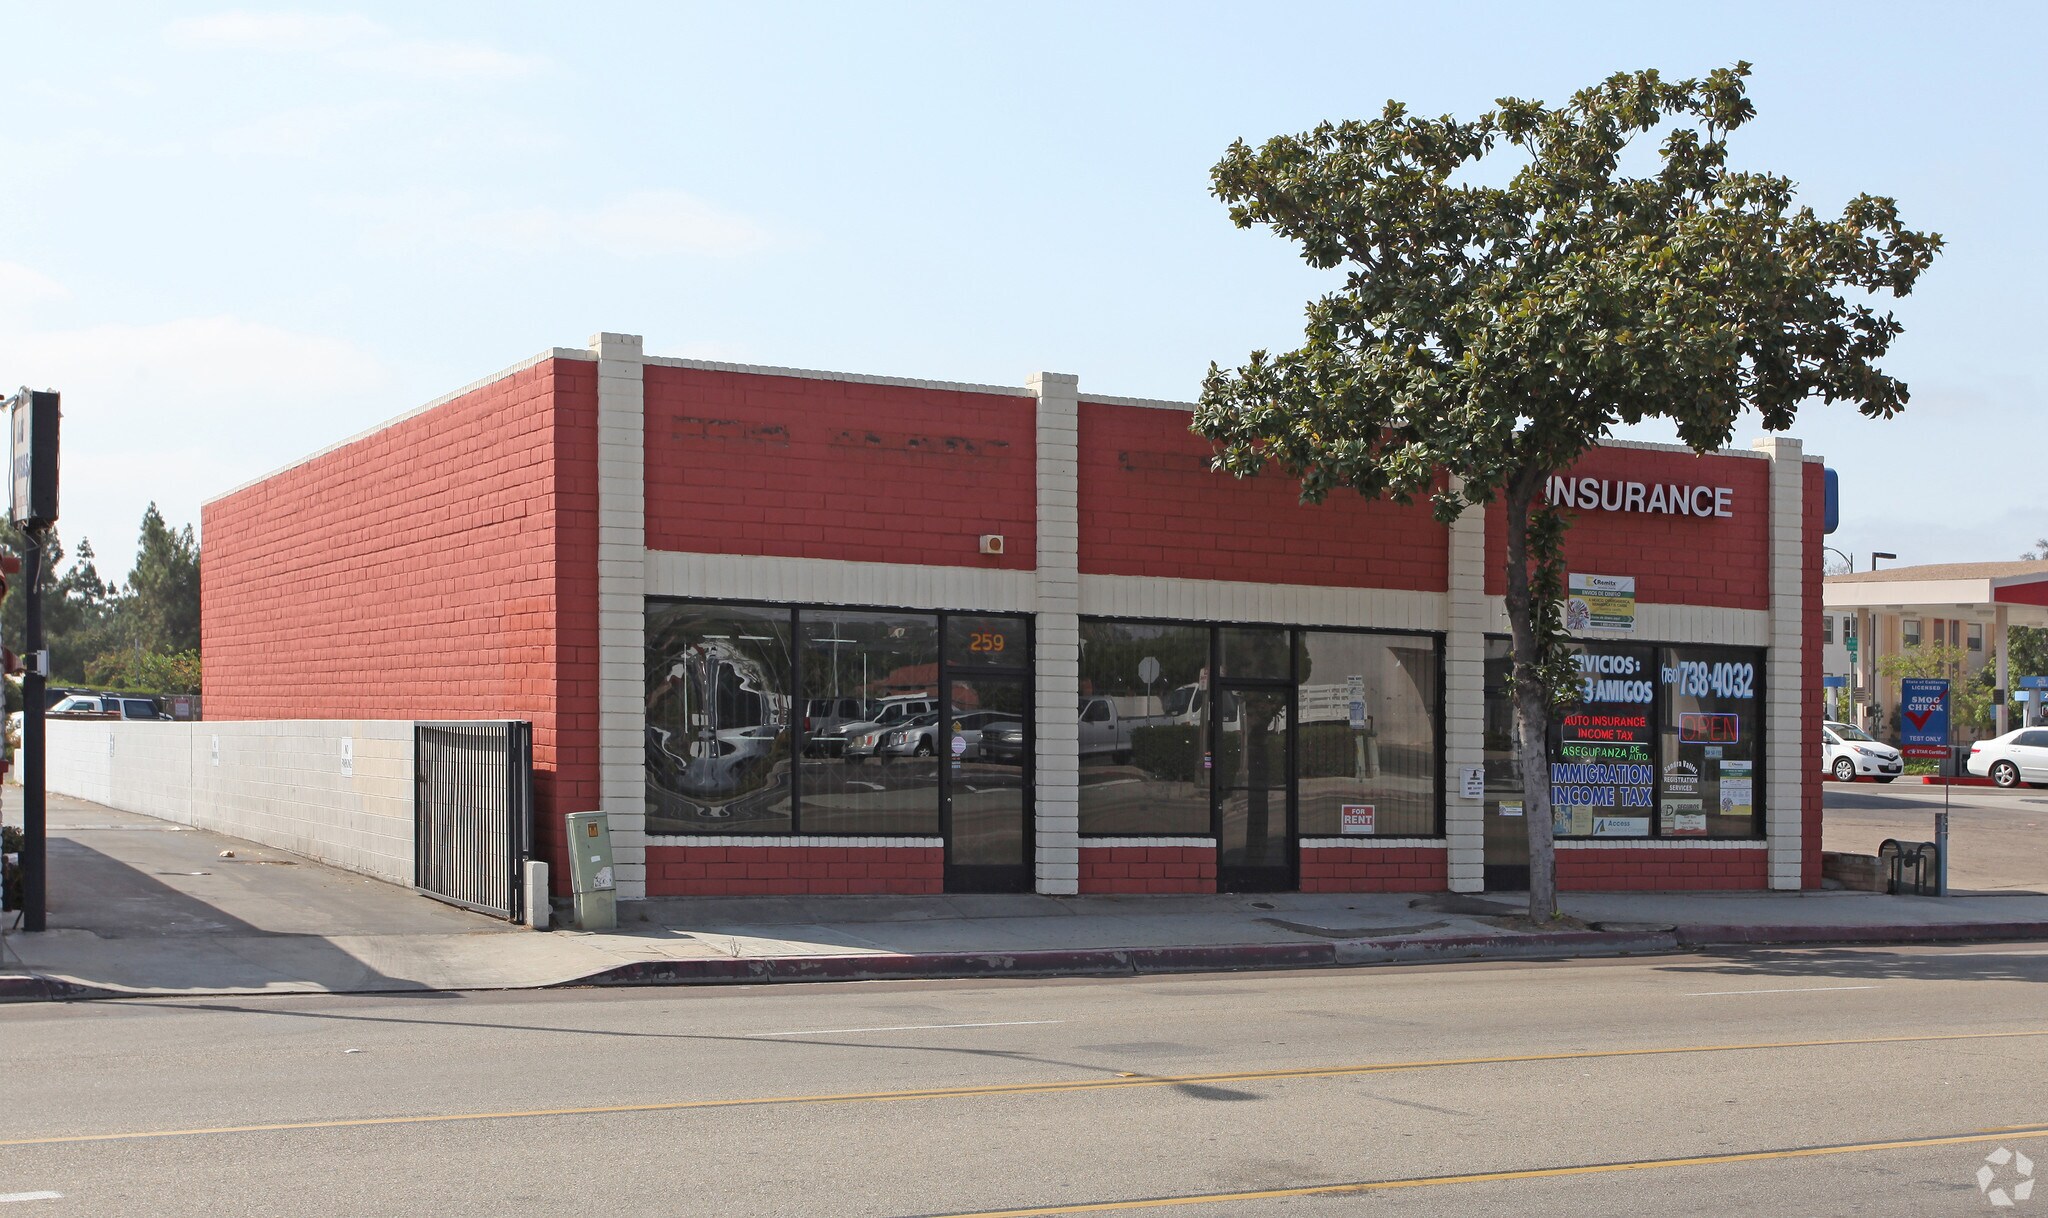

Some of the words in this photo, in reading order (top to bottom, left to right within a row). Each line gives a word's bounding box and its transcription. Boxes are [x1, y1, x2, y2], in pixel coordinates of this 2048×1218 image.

[1545, 475, 1733, 518] INSURANCE
[970, 633, 1004, 651] 259
[1661, 663, 1680, 685] (760)
[1595, 680, 1653, 703] AMIGOS
[1911, 696, 1941, 704] SMOG
[1908, 703, 1943, 712] CHECK
[1564, 715, 1590, 726] AUTO
[1592, 716, 1646, 727] INSURANCE
[1681, 715, 1737, 741] OPEN
[1578, 728, 1614, 740] INCOME
[1616, 730, 1633, 741] TAX
[1551, 763, 1653, 784] IMMIGRATION
[1551, 785, 1615, 807] INCOME
[1620, 786, 1653, 807] TAX
[1669, 784, 1693, 792] SERVICES
[1344, 815, 1372, 824] RENT
